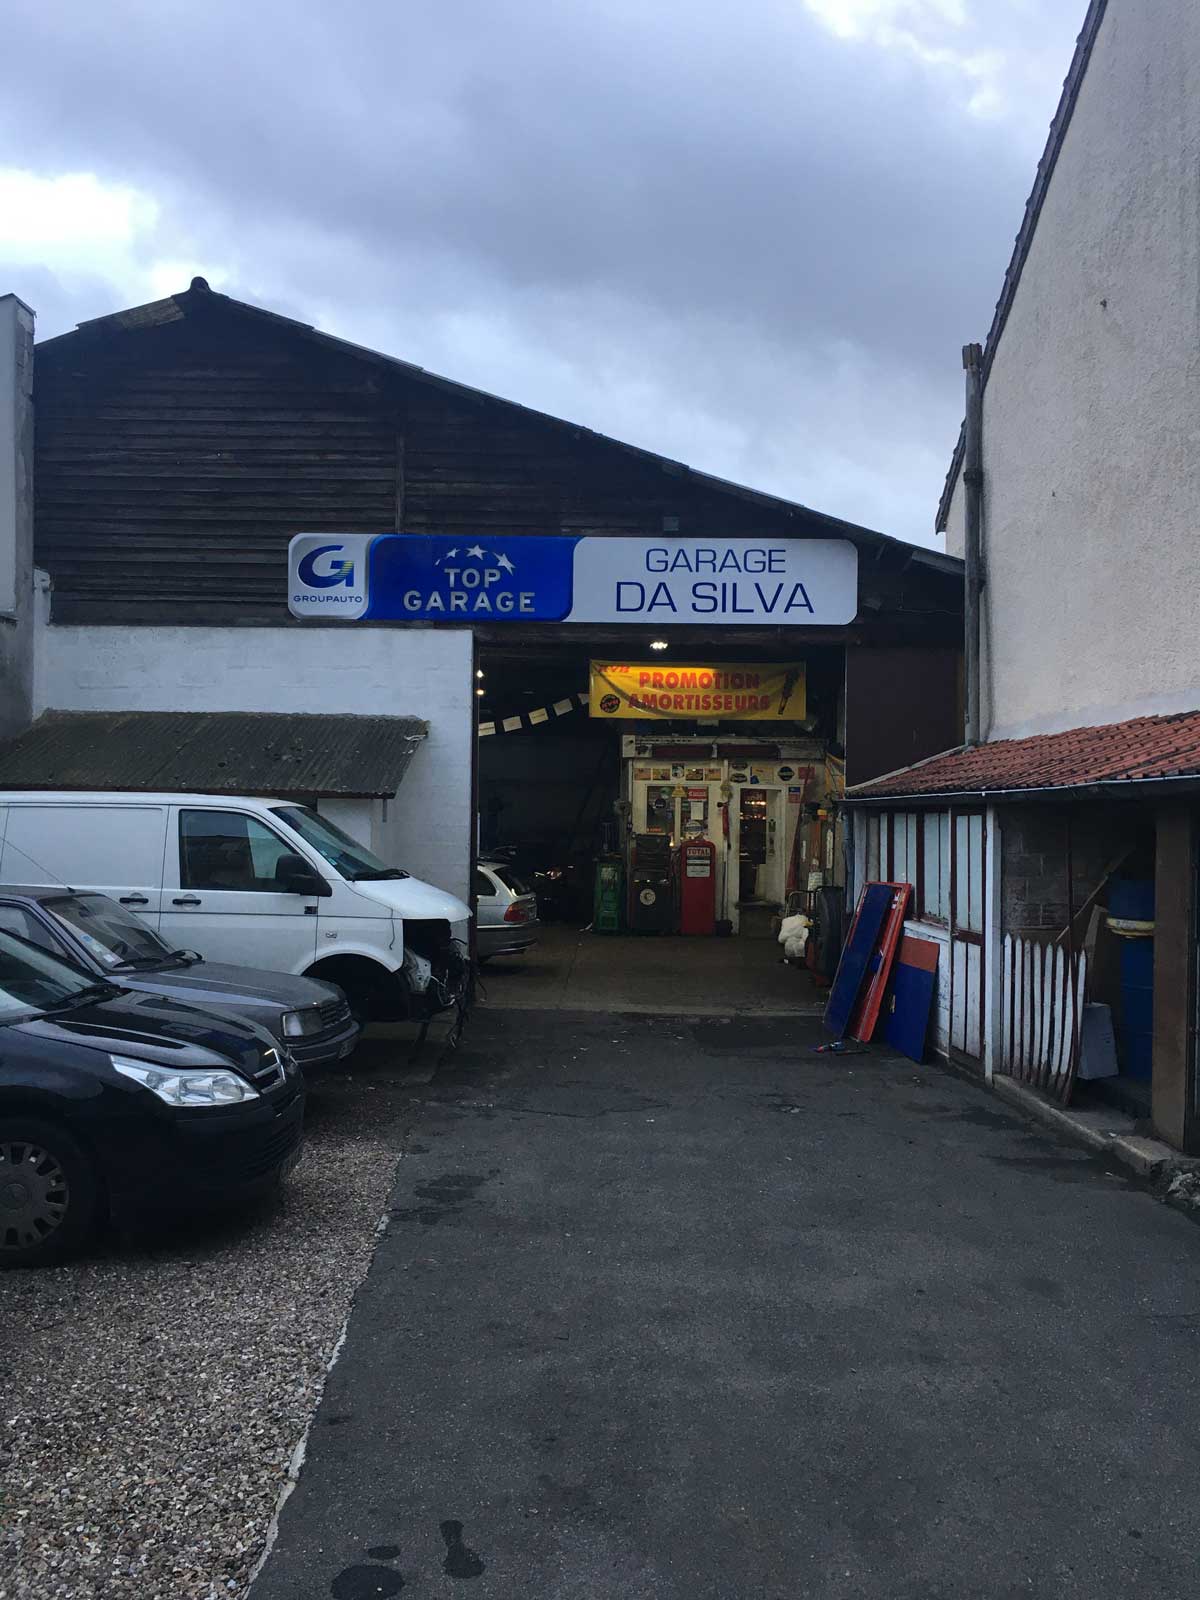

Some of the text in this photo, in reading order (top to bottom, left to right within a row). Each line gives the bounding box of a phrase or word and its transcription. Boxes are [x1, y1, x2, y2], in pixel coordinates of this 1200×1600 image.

[646, 549, 786, 573] GARAGE
[444, 567, 501, 588] TOP
[293, 594, 363, 603] GROUPAUTO
[403, 591, 535, 612] GARAGE
[616, 582, 814, 613] DA SILVA
[639, 672, 760, 690] PROMOTION
[629, 694, 769, 711] AMORTISSEURS
